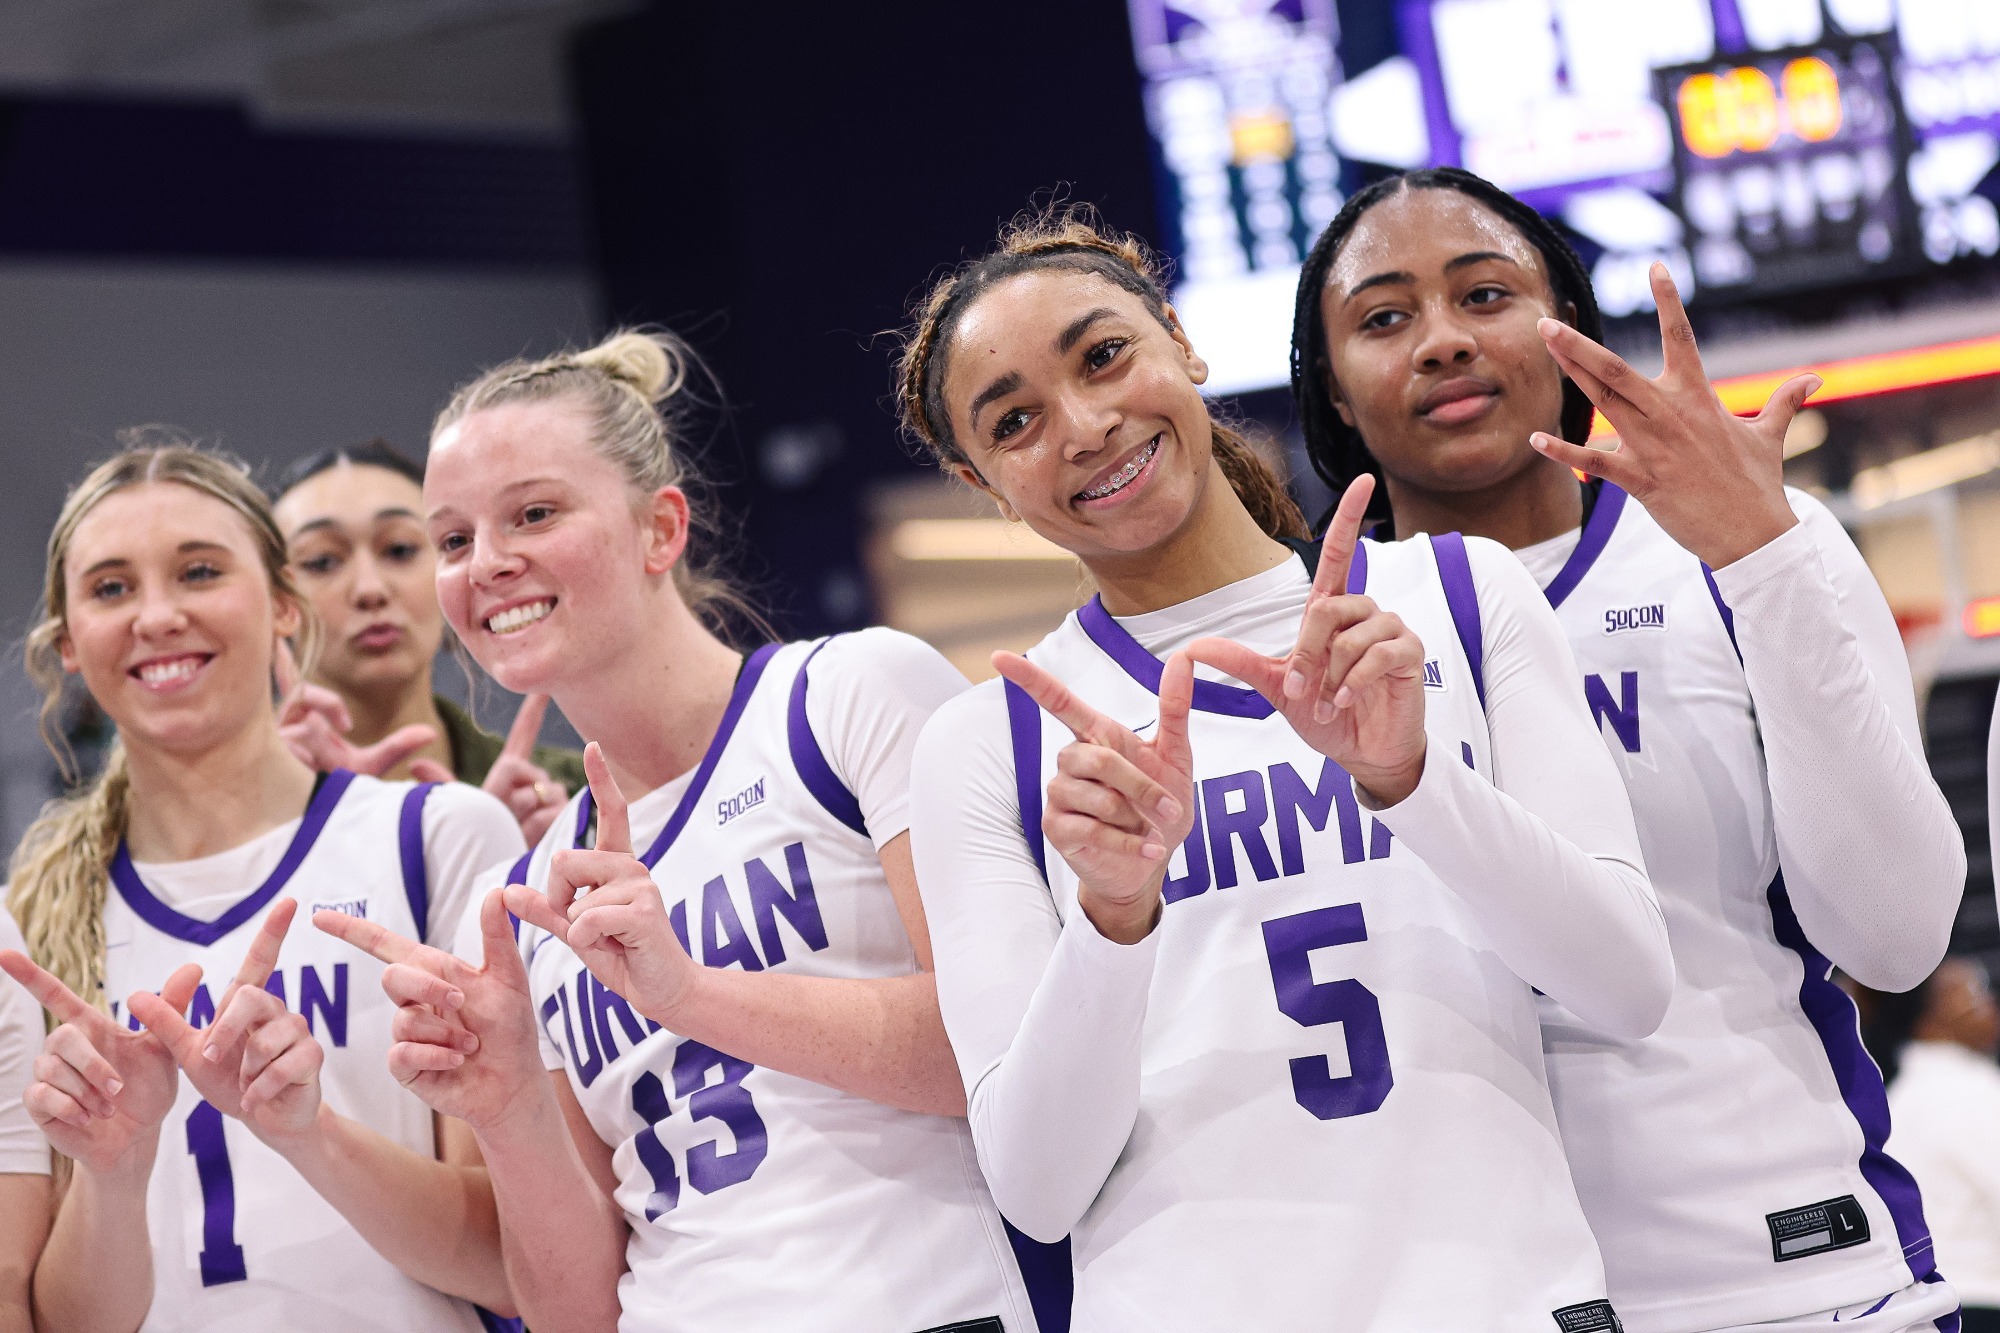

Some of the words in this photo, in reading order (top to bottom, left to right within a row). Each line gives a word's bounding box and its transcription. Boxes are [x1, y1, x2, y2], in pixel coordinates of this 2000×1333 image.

[1606, 605, 1664, 633] SOCON
[718, 777, 765, 826] SOCON
[1261, 902, 1394, 1120] 5
[632, 1039, 768, 1223] 13
[186, 1100, 247, 1287] 1
[1775, 1210, 1824, 1227] ENGINEERED
[1840, 1213, 1854, 1231] L
